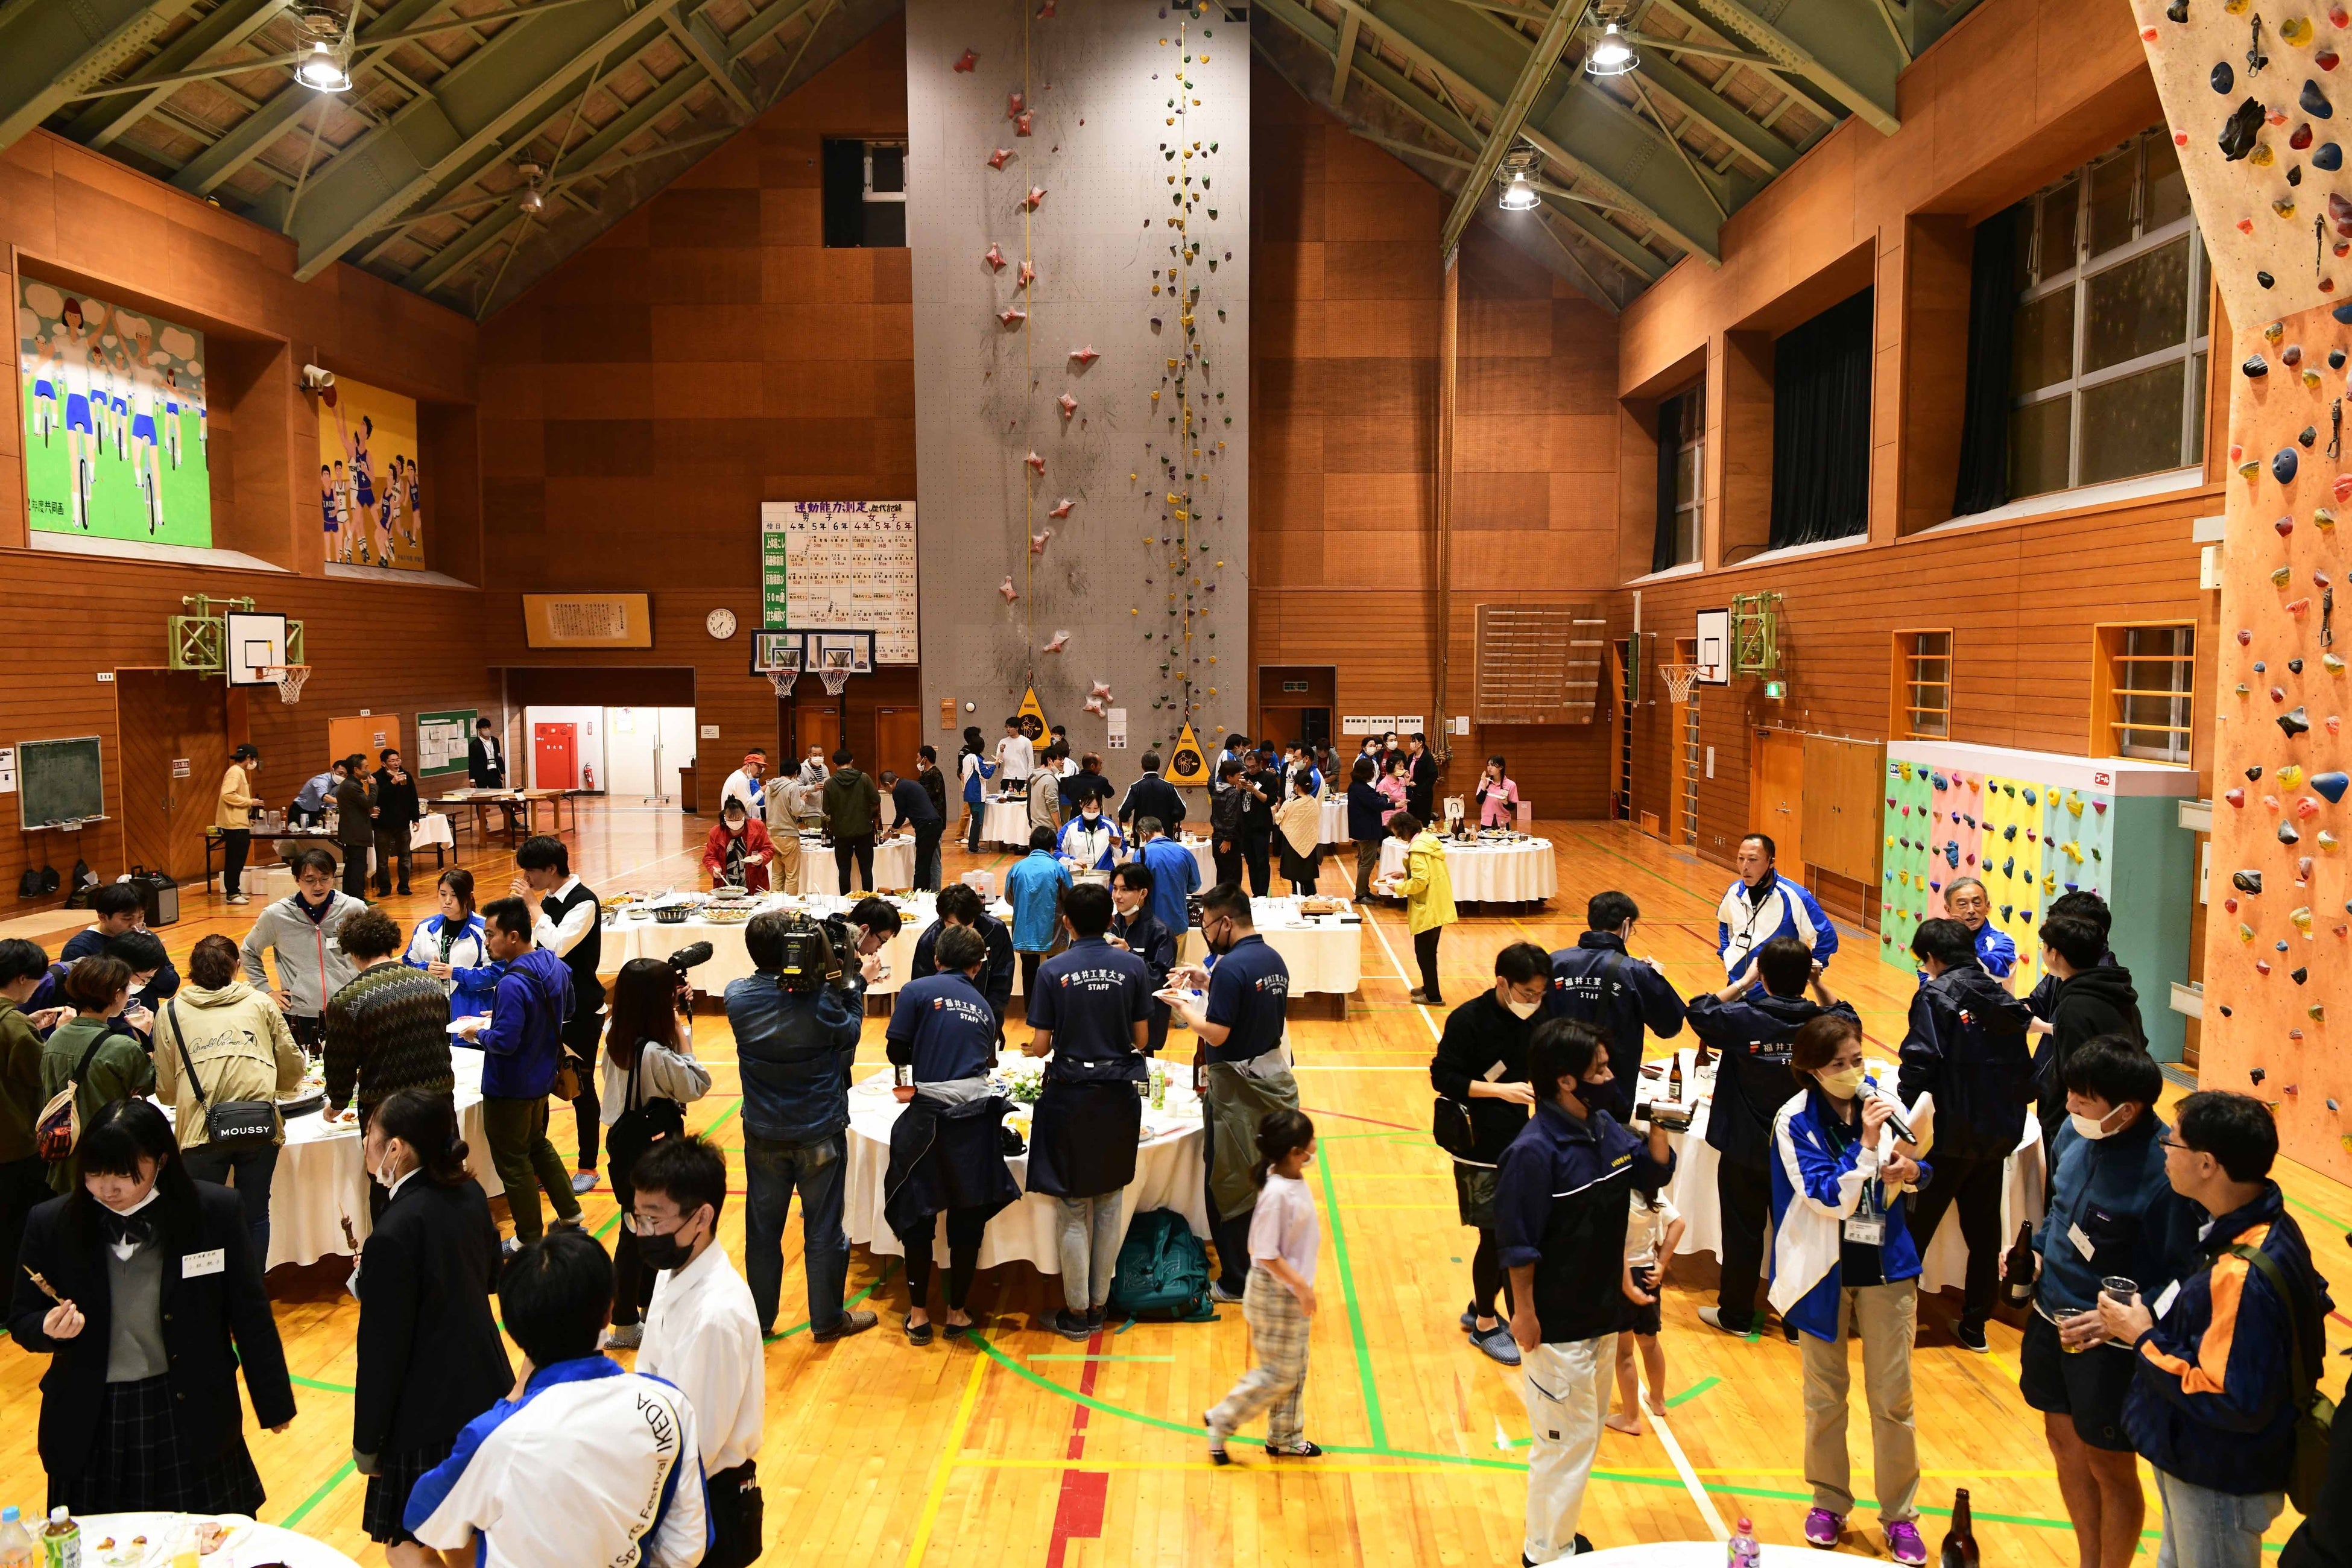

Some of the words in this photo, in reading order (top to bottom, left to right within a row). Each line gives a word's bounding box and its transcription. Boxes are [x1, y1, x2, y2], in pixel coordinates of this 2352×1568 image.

[794, 501, 868, 513] 運動能力測定
[2096, 774, 2109, 783] ゴール
[1070, 969, 1126, 982] 福井工業大学
[1565, 976, 1622, 991] 福井工業学
[960, 1013, 979, 1023] STAFF
[1763, 1043, 1794, 1052] 福井工
[221, 1126, 270, 1137] MOUSSY
[637, 1392, 672, 1452] IKEDA
[639, 1458, 668, 1519] Festival
[616, 1522, 645, 1566] Sprts
